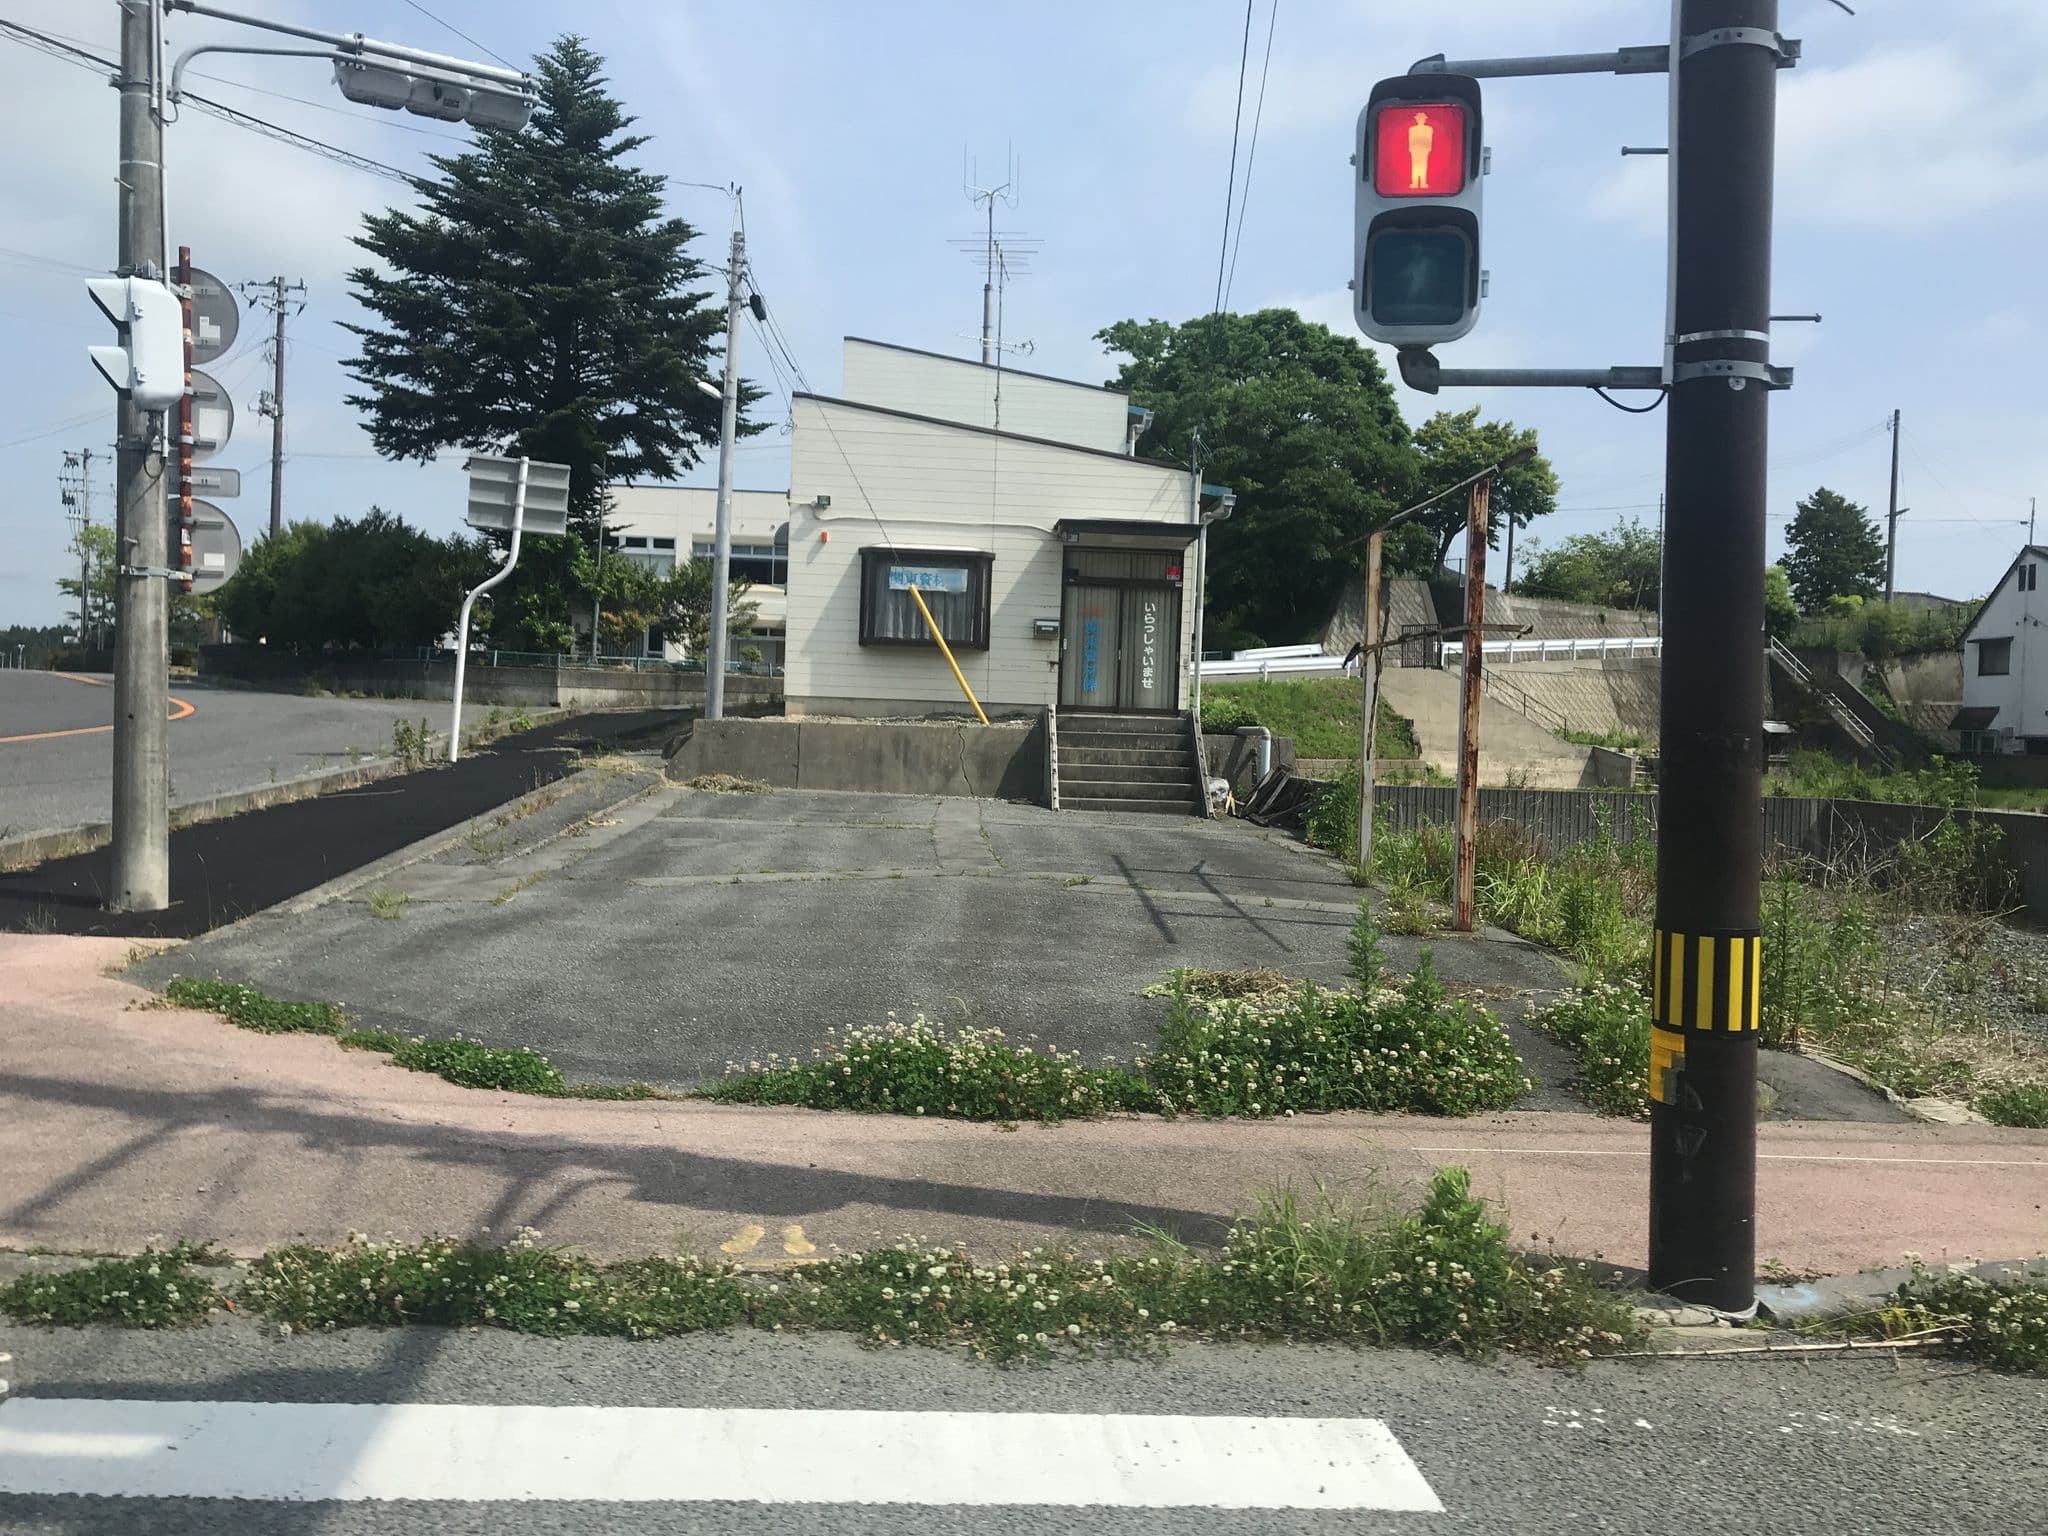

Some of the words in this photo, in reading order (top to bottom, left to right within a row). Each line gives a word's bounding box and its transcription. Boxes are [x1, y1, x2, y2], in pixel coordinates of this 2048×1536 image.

[1141, 602, 1156, 689] いらっしゃいませ
